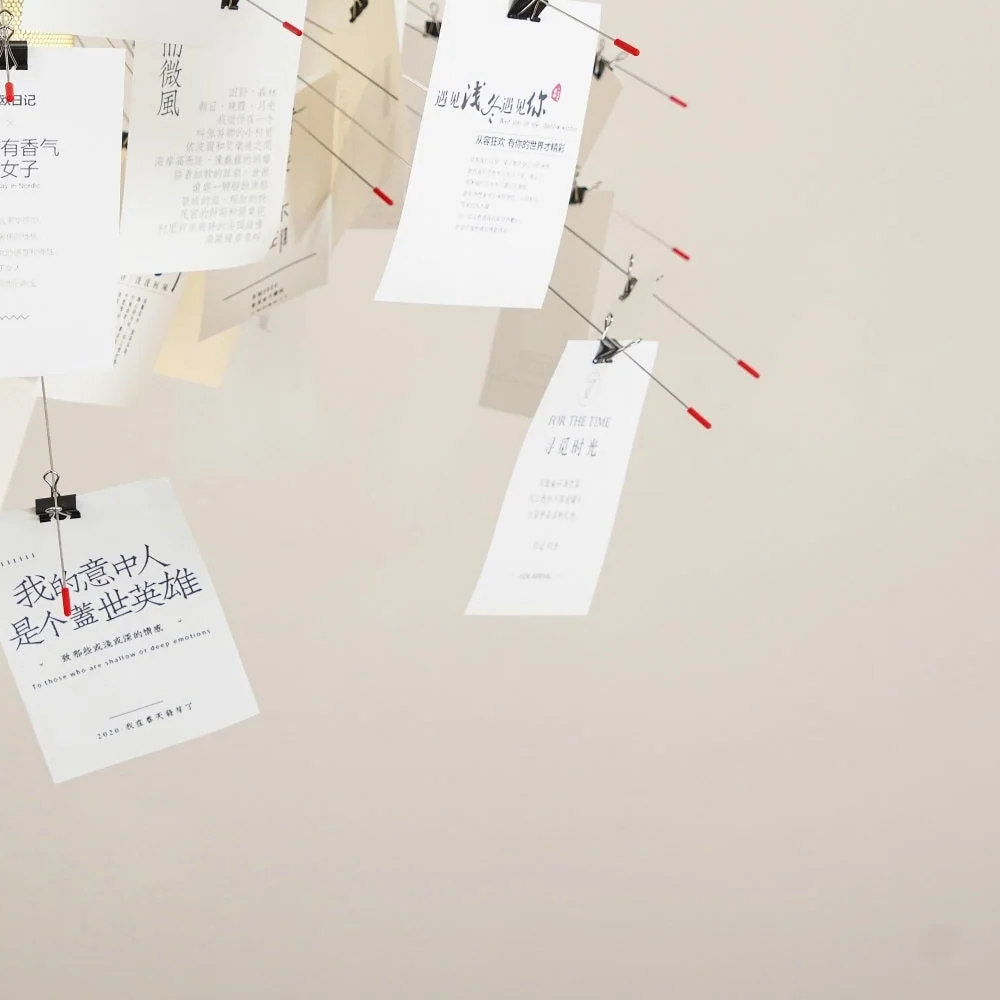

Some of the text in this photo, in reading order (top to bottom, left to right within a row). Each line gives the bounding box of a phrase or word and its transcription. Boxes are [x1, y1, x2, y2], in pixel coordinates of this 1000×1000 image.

[434, 80, 549, 124] 遇见浅冬遇见你
[475, 134, 566, 154] 从容狂欢 有你的世界才精彩
[568, 415, 588, 428] THE
[588, 415, 612, 429] TIME
[12, 543, 172, 609] 我的意中人
[44, 673, 67, 687] those
[70, 666, 87, 678] who
[89, 663, 103, 672] are
[105, 651, 137, 667] shallow
[138, 648, 148, 656] or
[150, 641, 171, 652] deep
[173, 628, 212, 645] emotions
[97, 727, 121, 740] 2020
